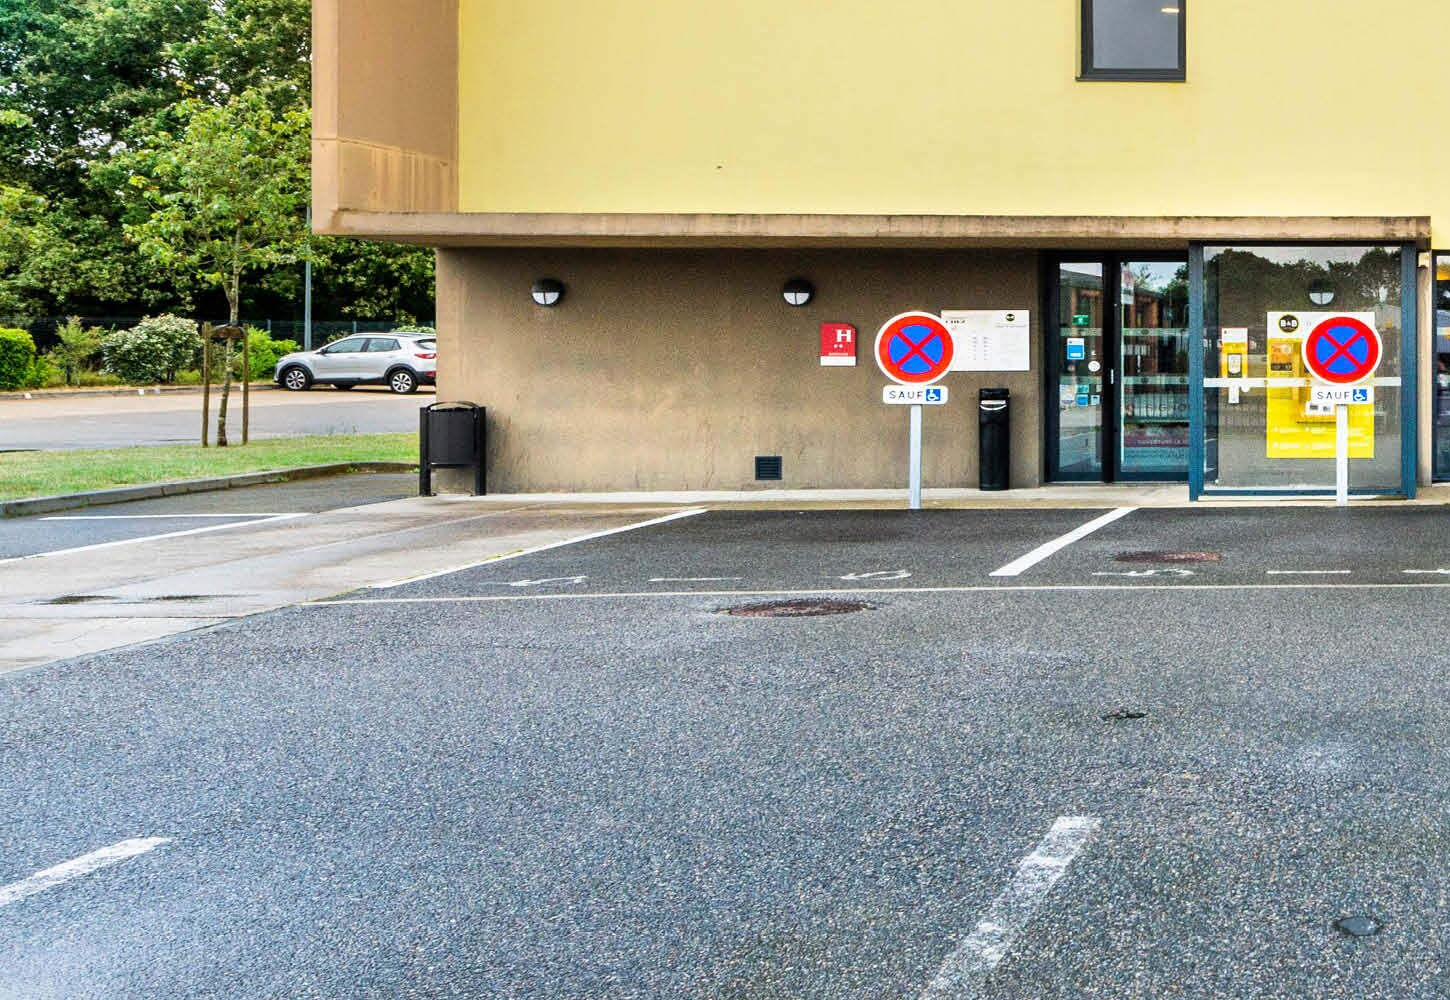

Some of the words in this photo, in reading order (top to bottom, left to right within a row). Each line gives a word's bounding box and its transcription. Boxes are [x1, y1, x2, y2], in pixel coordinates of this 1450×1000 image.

[836, 329, 852, 343] H
[888, 390, 924, 400] SAUF
[1317, 391, 1350, 401] SAUF
